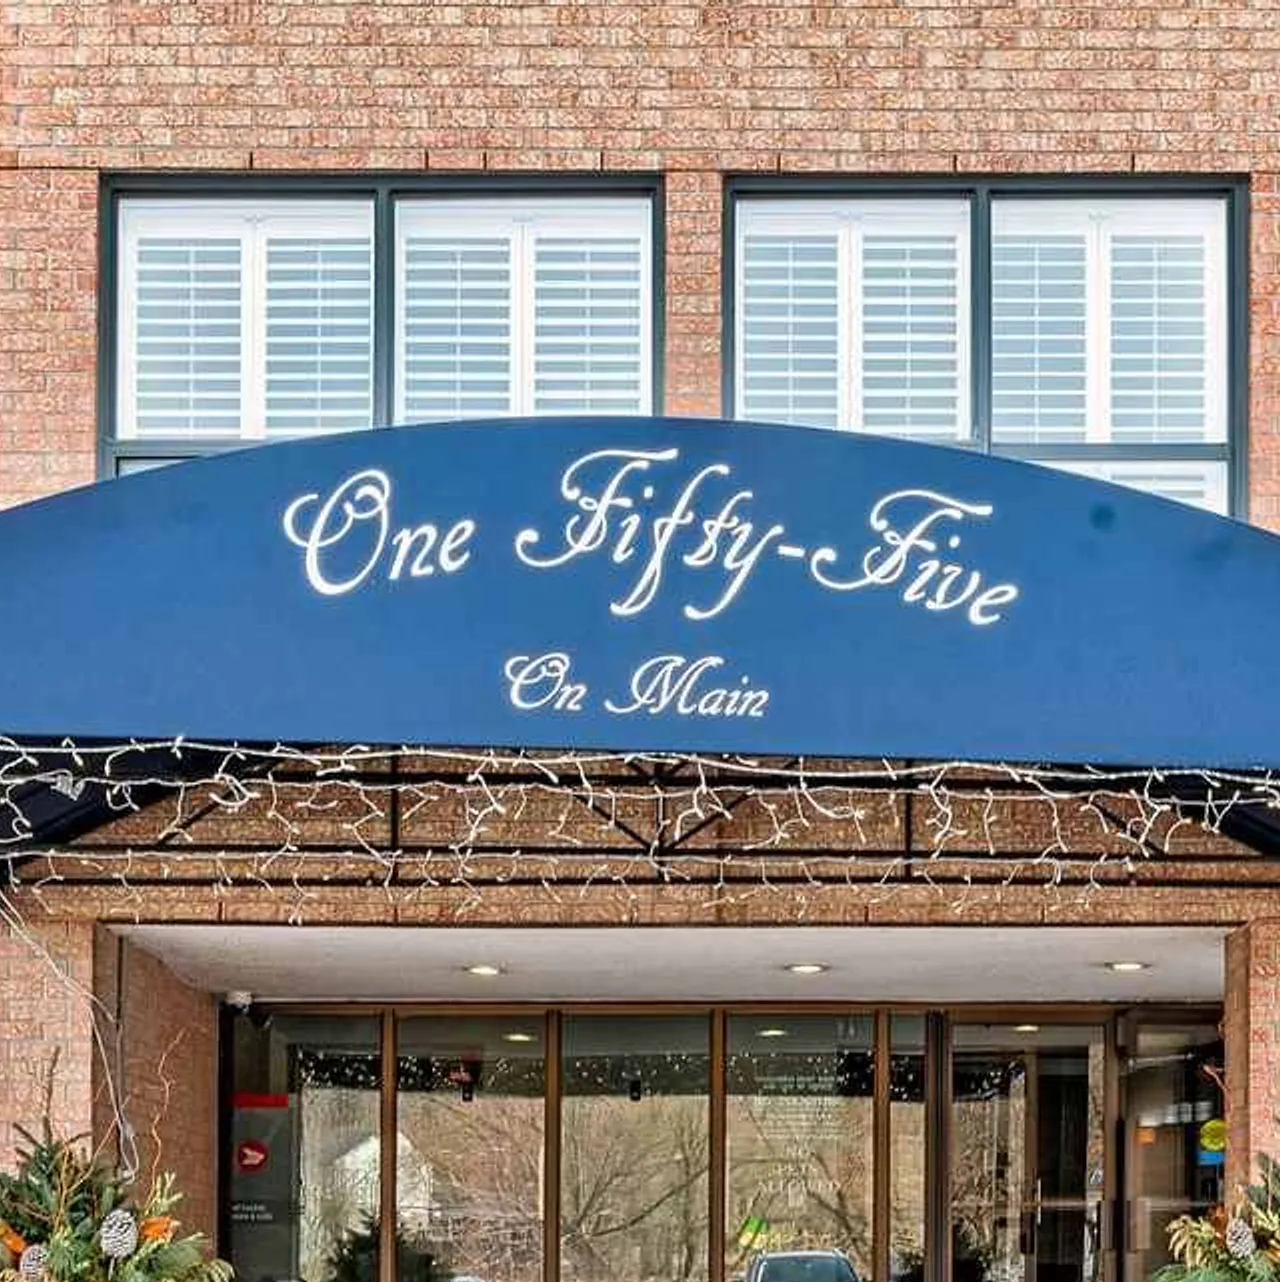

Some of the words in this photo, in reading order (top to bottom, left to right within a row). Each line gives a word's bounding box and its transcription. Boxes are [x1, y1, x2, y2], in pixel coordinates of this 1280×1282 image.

[283, 468, 476, 596] One
[515, 448, 1018, 625] Fifty-Five
[504, 652, 588, 710] On
[604, 655, 770, 717] Main
